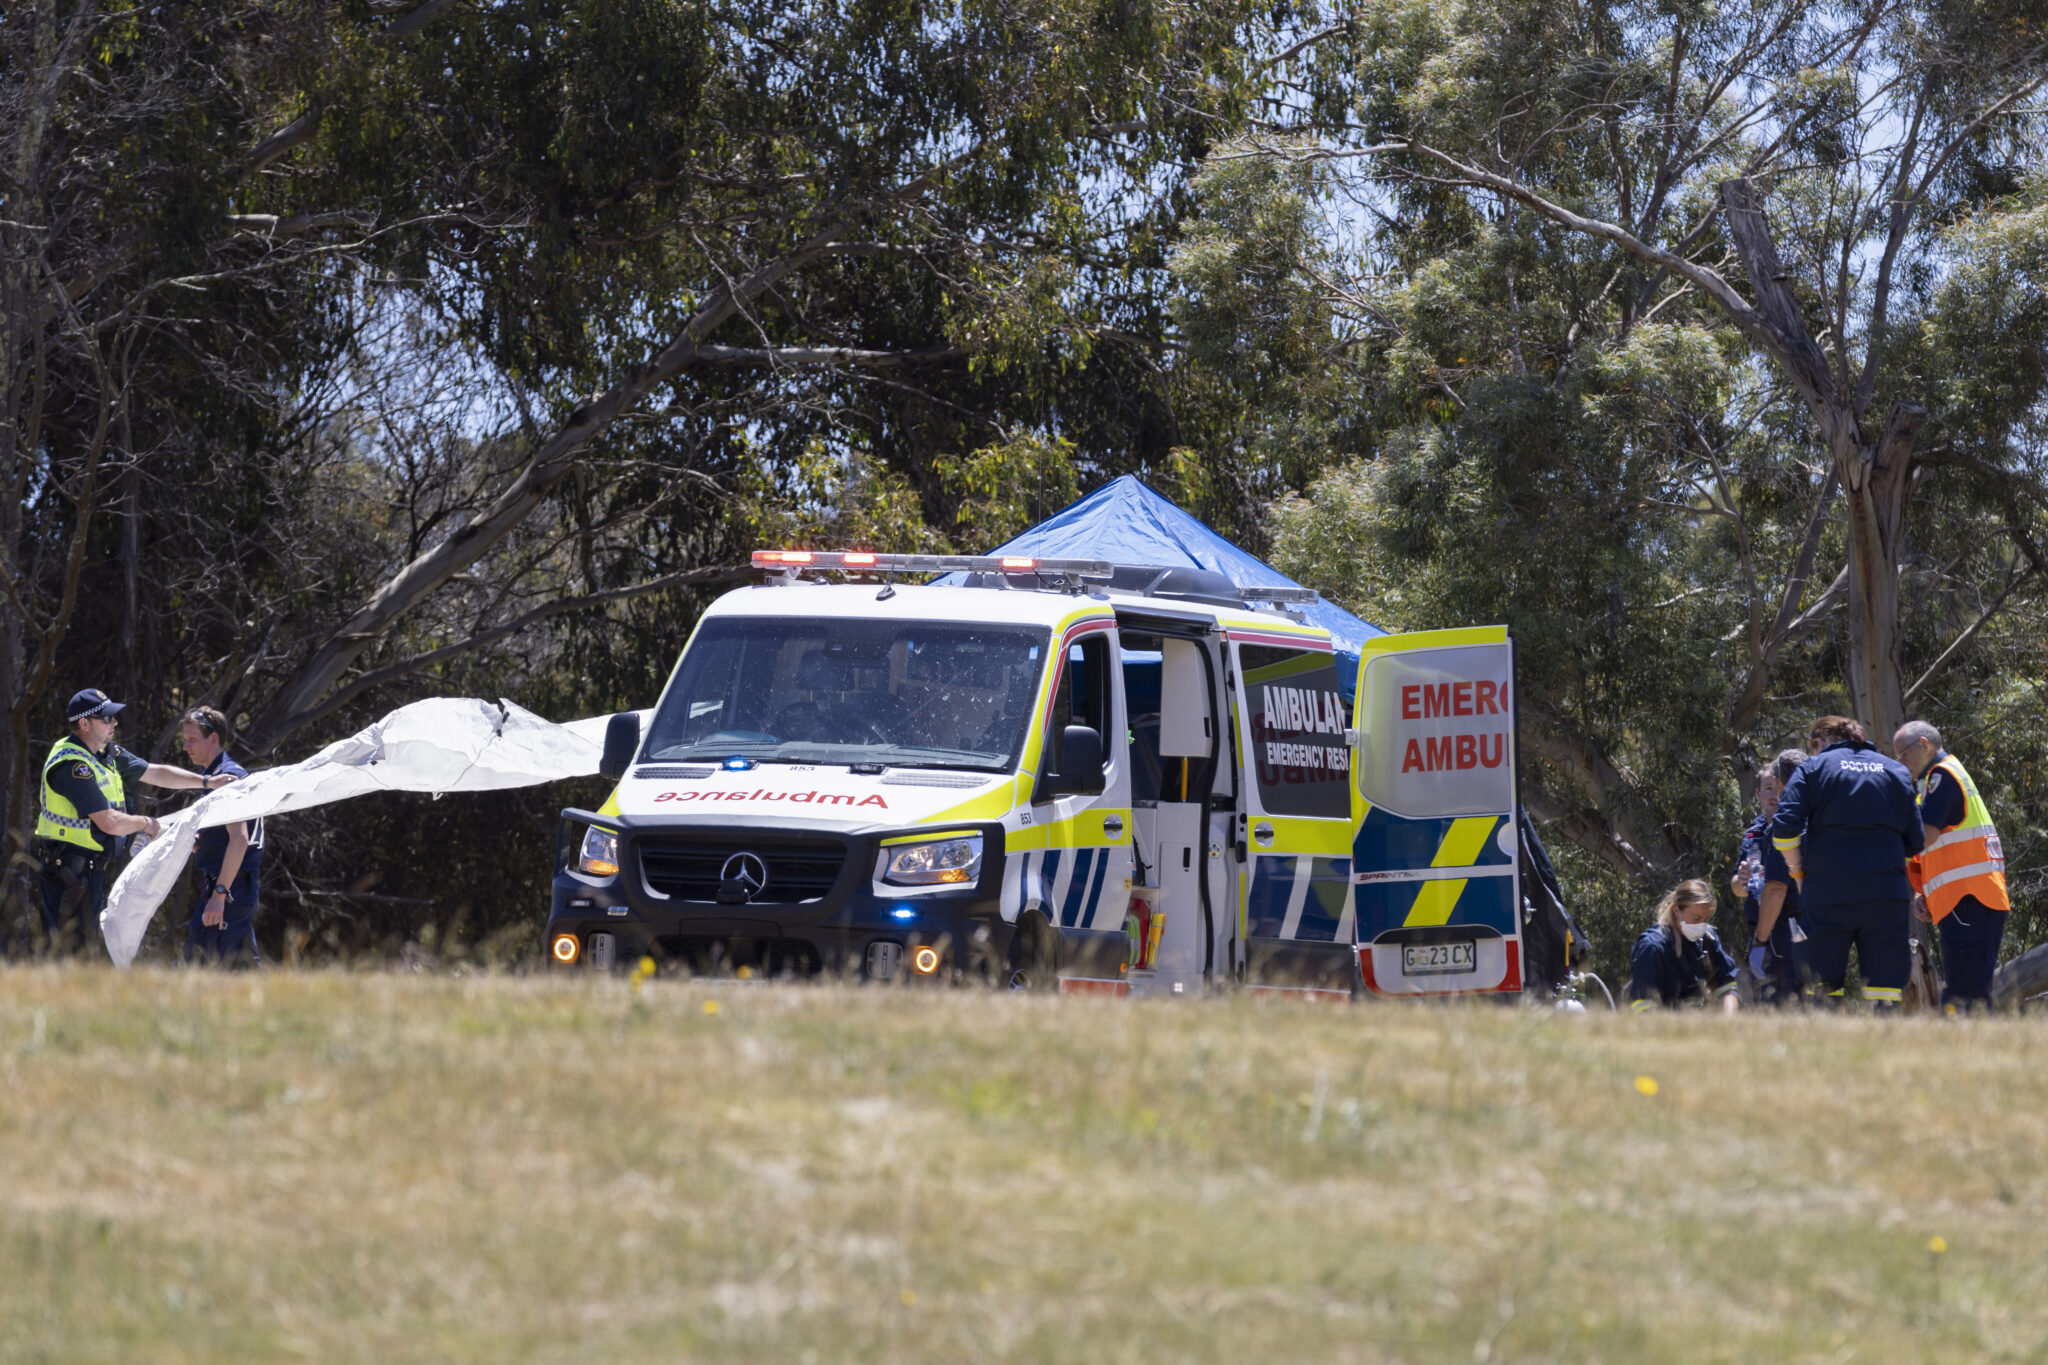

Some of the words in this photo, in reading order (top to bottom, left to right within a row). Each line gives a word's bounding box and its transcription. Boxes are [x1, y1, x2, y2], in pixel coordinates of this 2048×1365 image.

[1266, 742, 1324, 768] EMERGENCY
[1402, 733, 1509, 773] AMBU
[1840, 760, 1884, 773] DOCTOR
[1020, 812, 1031, 824] 853
